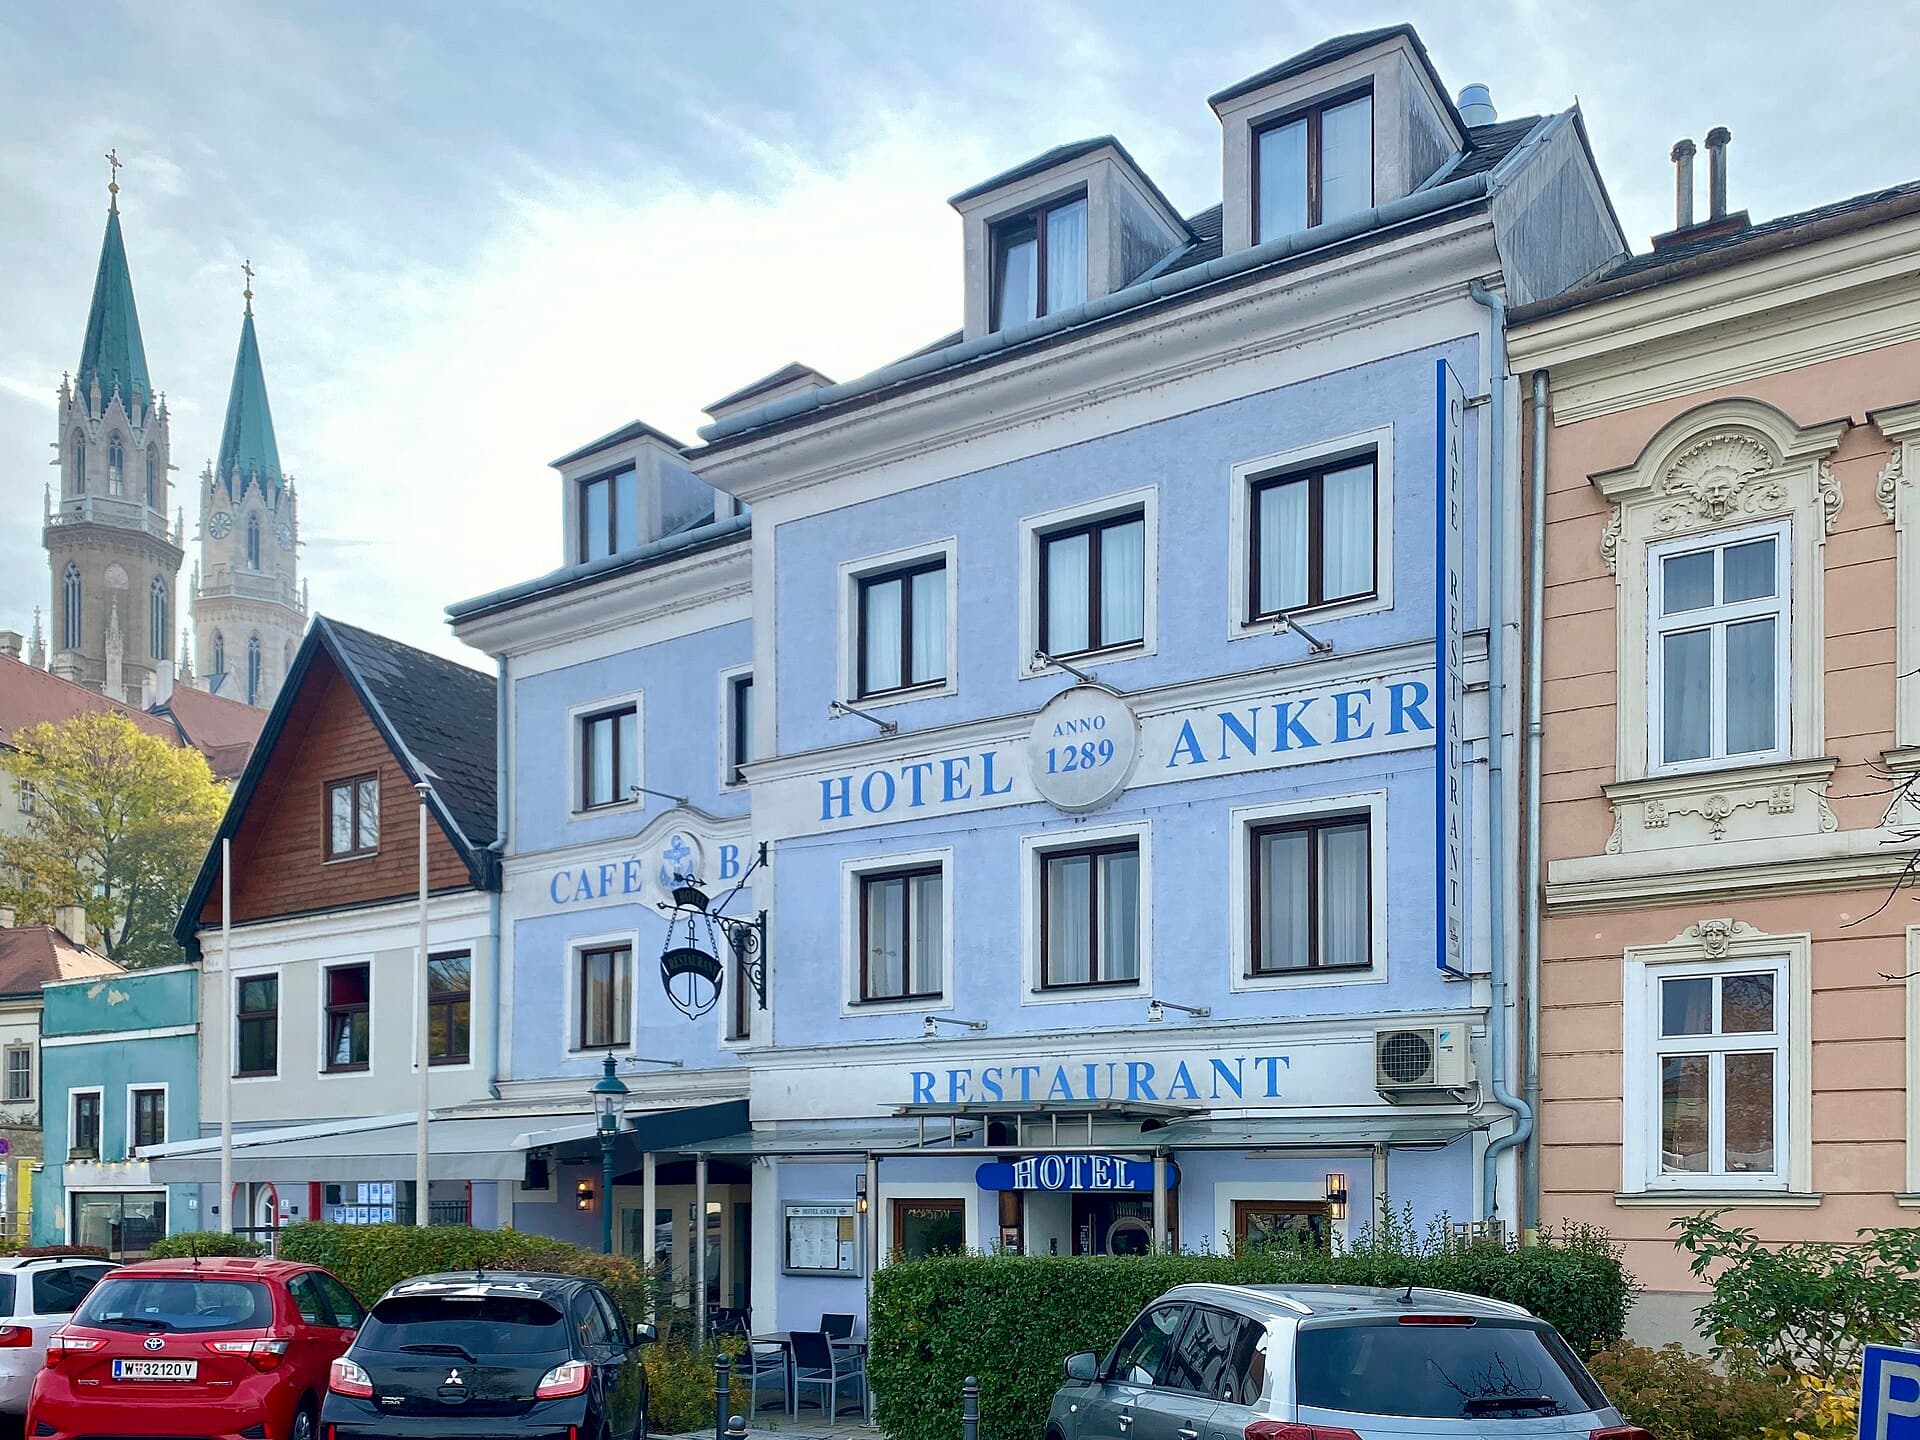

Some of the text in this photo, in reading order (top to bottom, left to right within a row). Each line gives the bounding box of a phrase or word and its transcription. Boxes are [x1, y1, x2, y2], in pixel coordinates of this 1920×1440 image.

[818, 680, 1435, 821] HOTEL ANKER
[1053, 715, 1106, 737] ANNO
[1449, 568, 1459, 907] RESTAURANT
[1045, 738, 1114, 775] 1289
[550, 854, 643, 905] CAFÉ
[909, 1055, 1291, 1105] RESTAURANT
[1012, 1154, 1136, 1190] HOTEL
[124, 1362, 192, 1376] W 32120 V
[1876, 1359, 1920, 1440] P
